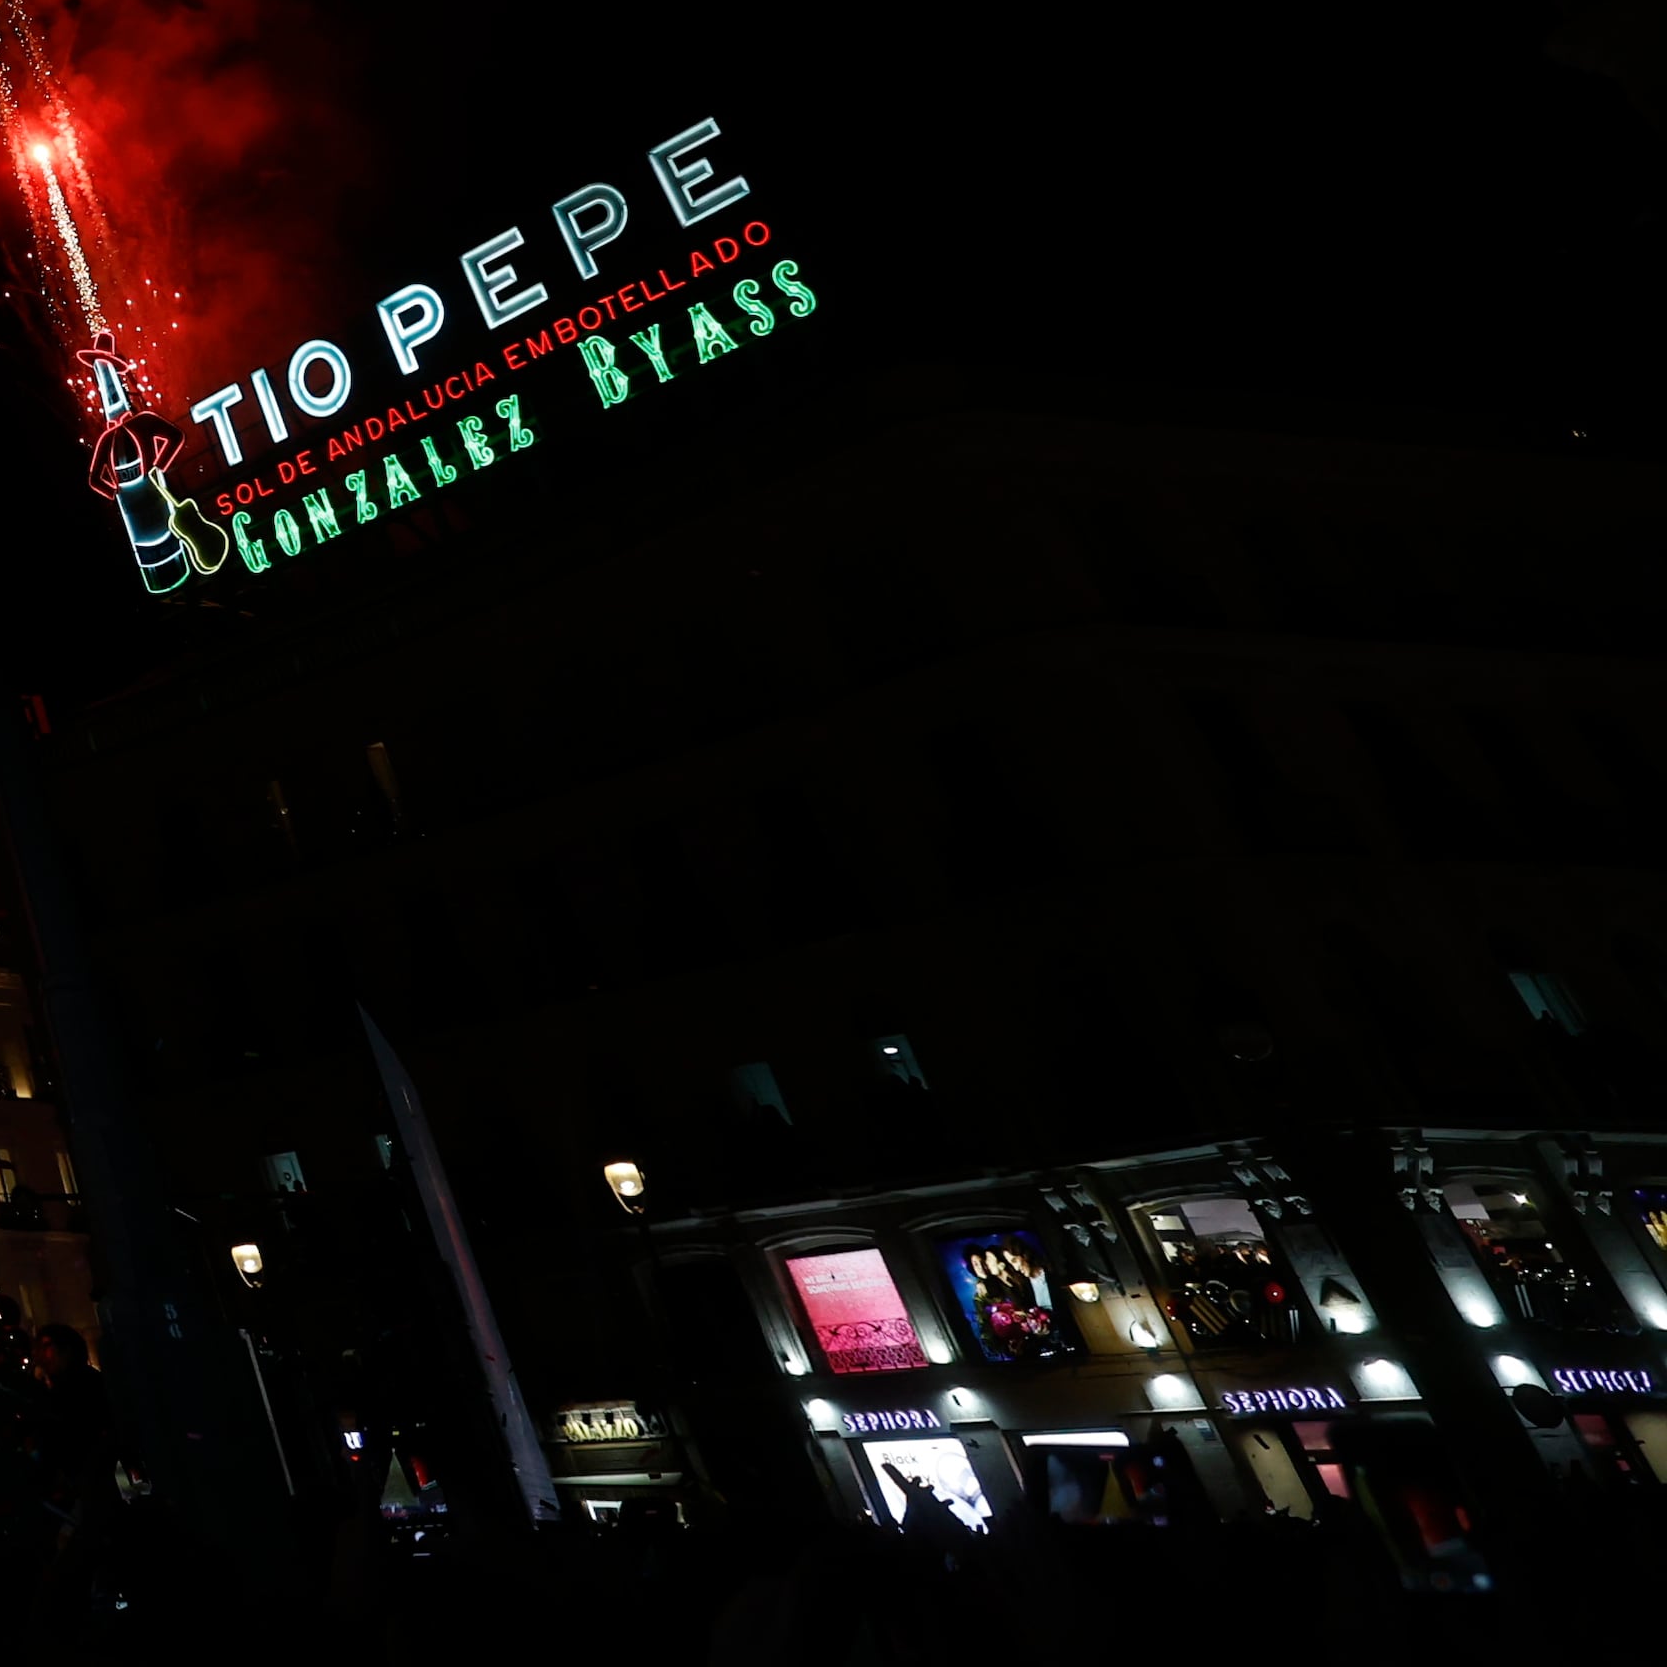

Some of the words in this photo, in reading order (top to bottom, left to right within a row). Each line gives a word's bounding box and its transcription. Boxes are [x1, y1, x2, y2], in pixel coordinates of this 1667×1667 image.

[190, 339, 351, 468] TIO
[376, 117, 750, 374] PEPE
[216, 481, 274, 516] SOL
[278, 450, 316, 485] DE
[328, 370, 495, 461] ANDALUCIA
[505, 221, 770, 371] EMBOTELLADO
[231, 394, 535, 575] GONZALEZ
[576, 259, 817, 409] BYASS
[843, 1409, 941, 1432] SEPHORA
[882, 1452, 917, 1464] Black
[1222, 1387, 1346, 1414] SEPHORA
